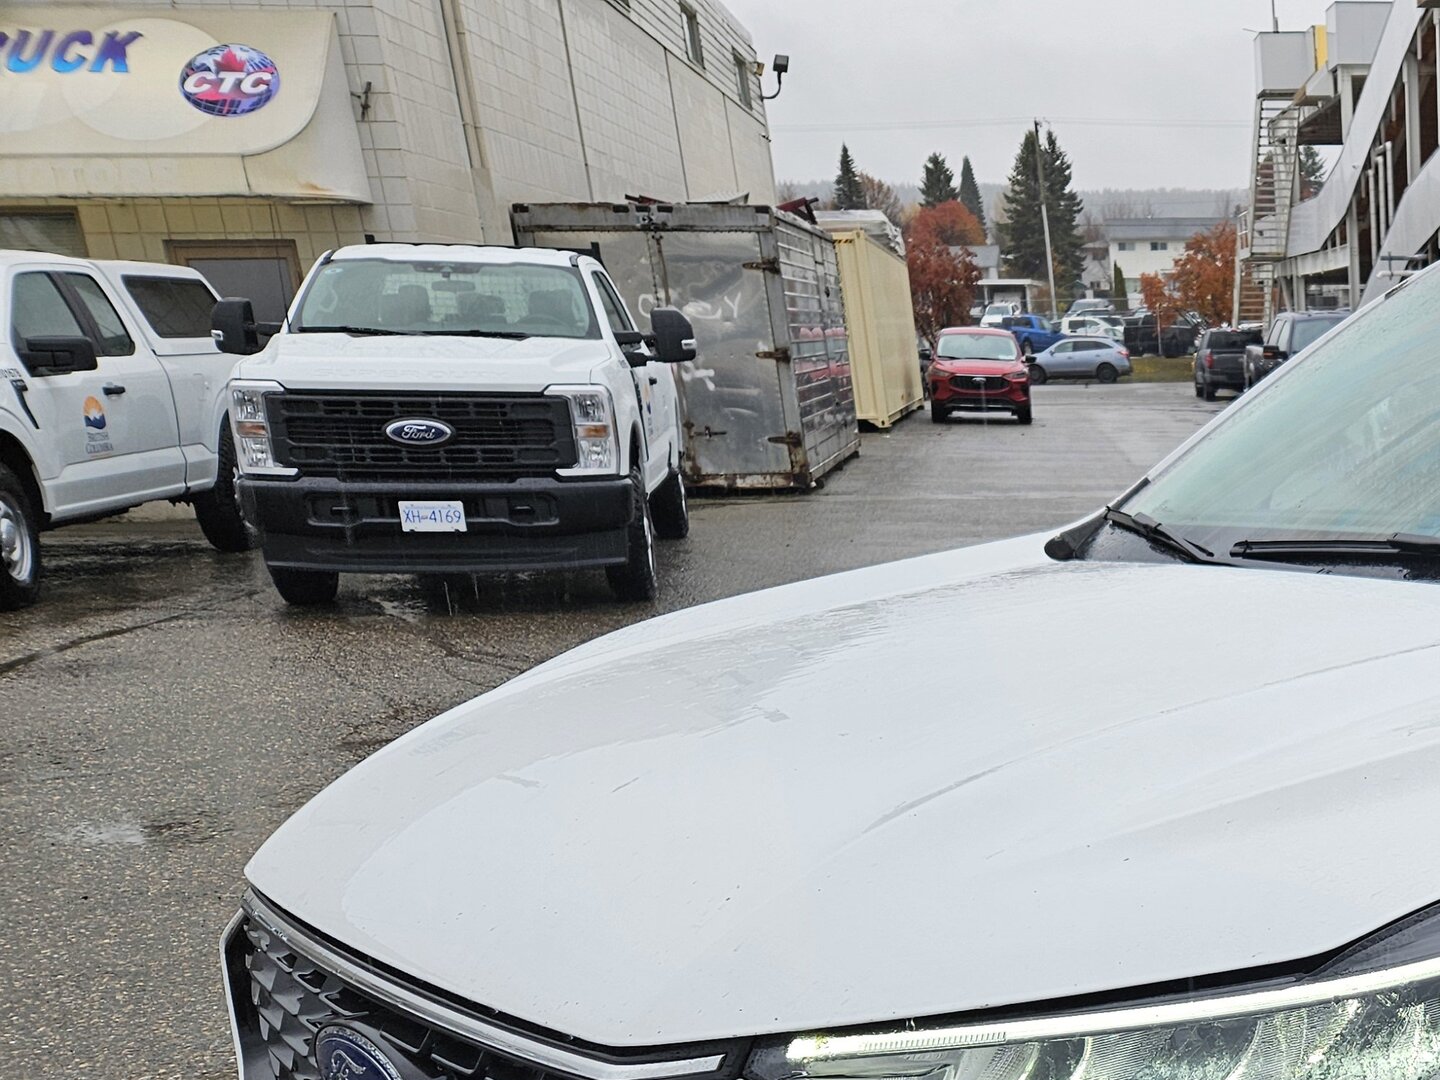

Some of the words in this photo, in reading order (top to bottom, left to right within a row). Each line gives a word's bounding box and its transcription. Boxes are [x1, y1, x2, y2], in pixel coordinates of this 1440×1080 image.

[0, 29, 144, 74] UCK
[183, 70, 273, 94] CTC
[401, 424, 436, 440] Ford
